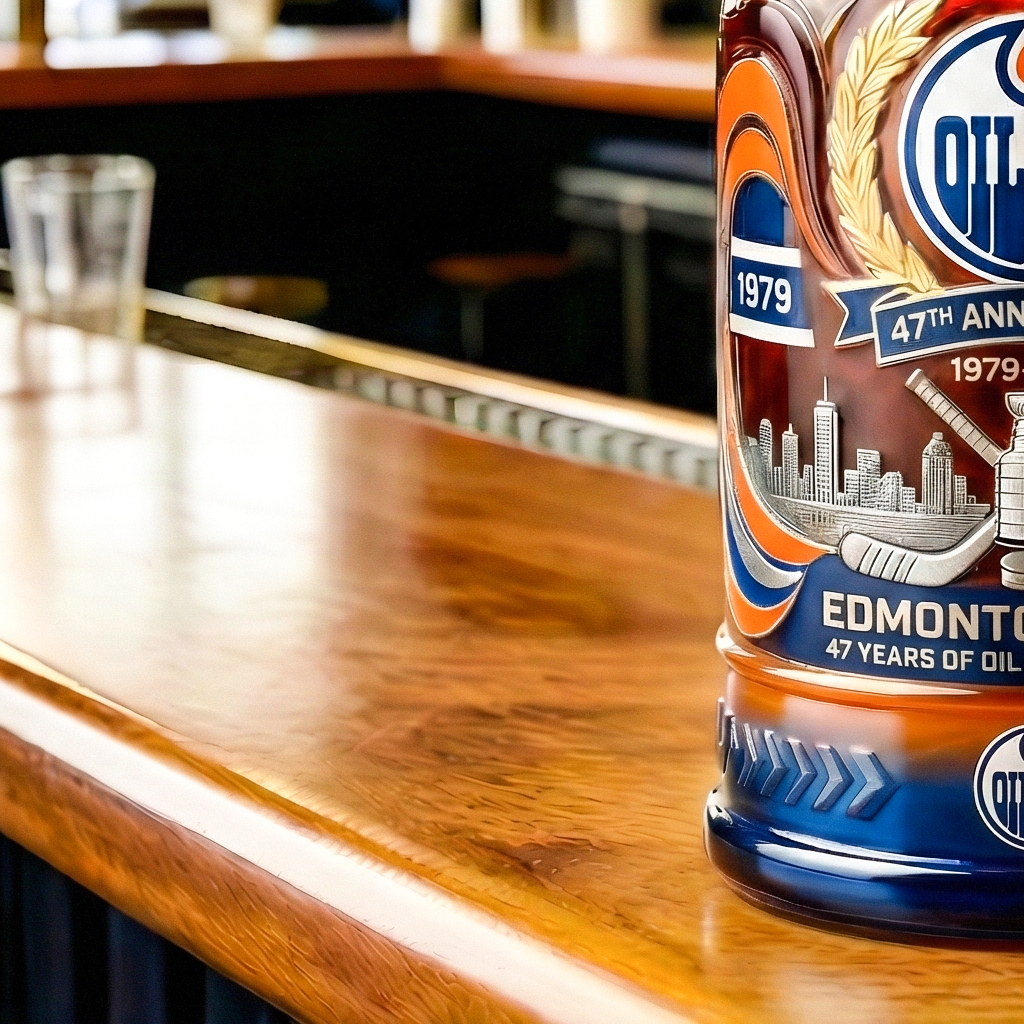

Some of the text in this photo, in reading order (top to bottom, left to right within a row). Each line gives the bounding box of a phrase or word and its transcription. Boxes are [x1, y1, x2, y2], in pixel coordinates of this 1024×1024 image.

[737, 271, 792, 314] 1979
[890, 305, 953, 343] 47TH
[825, 637, 853, 660] 47
[857, 641, 935, 669] YEARS
[942, 649, 975, 671] OF
[981, 650, 1022, 672] OIL
